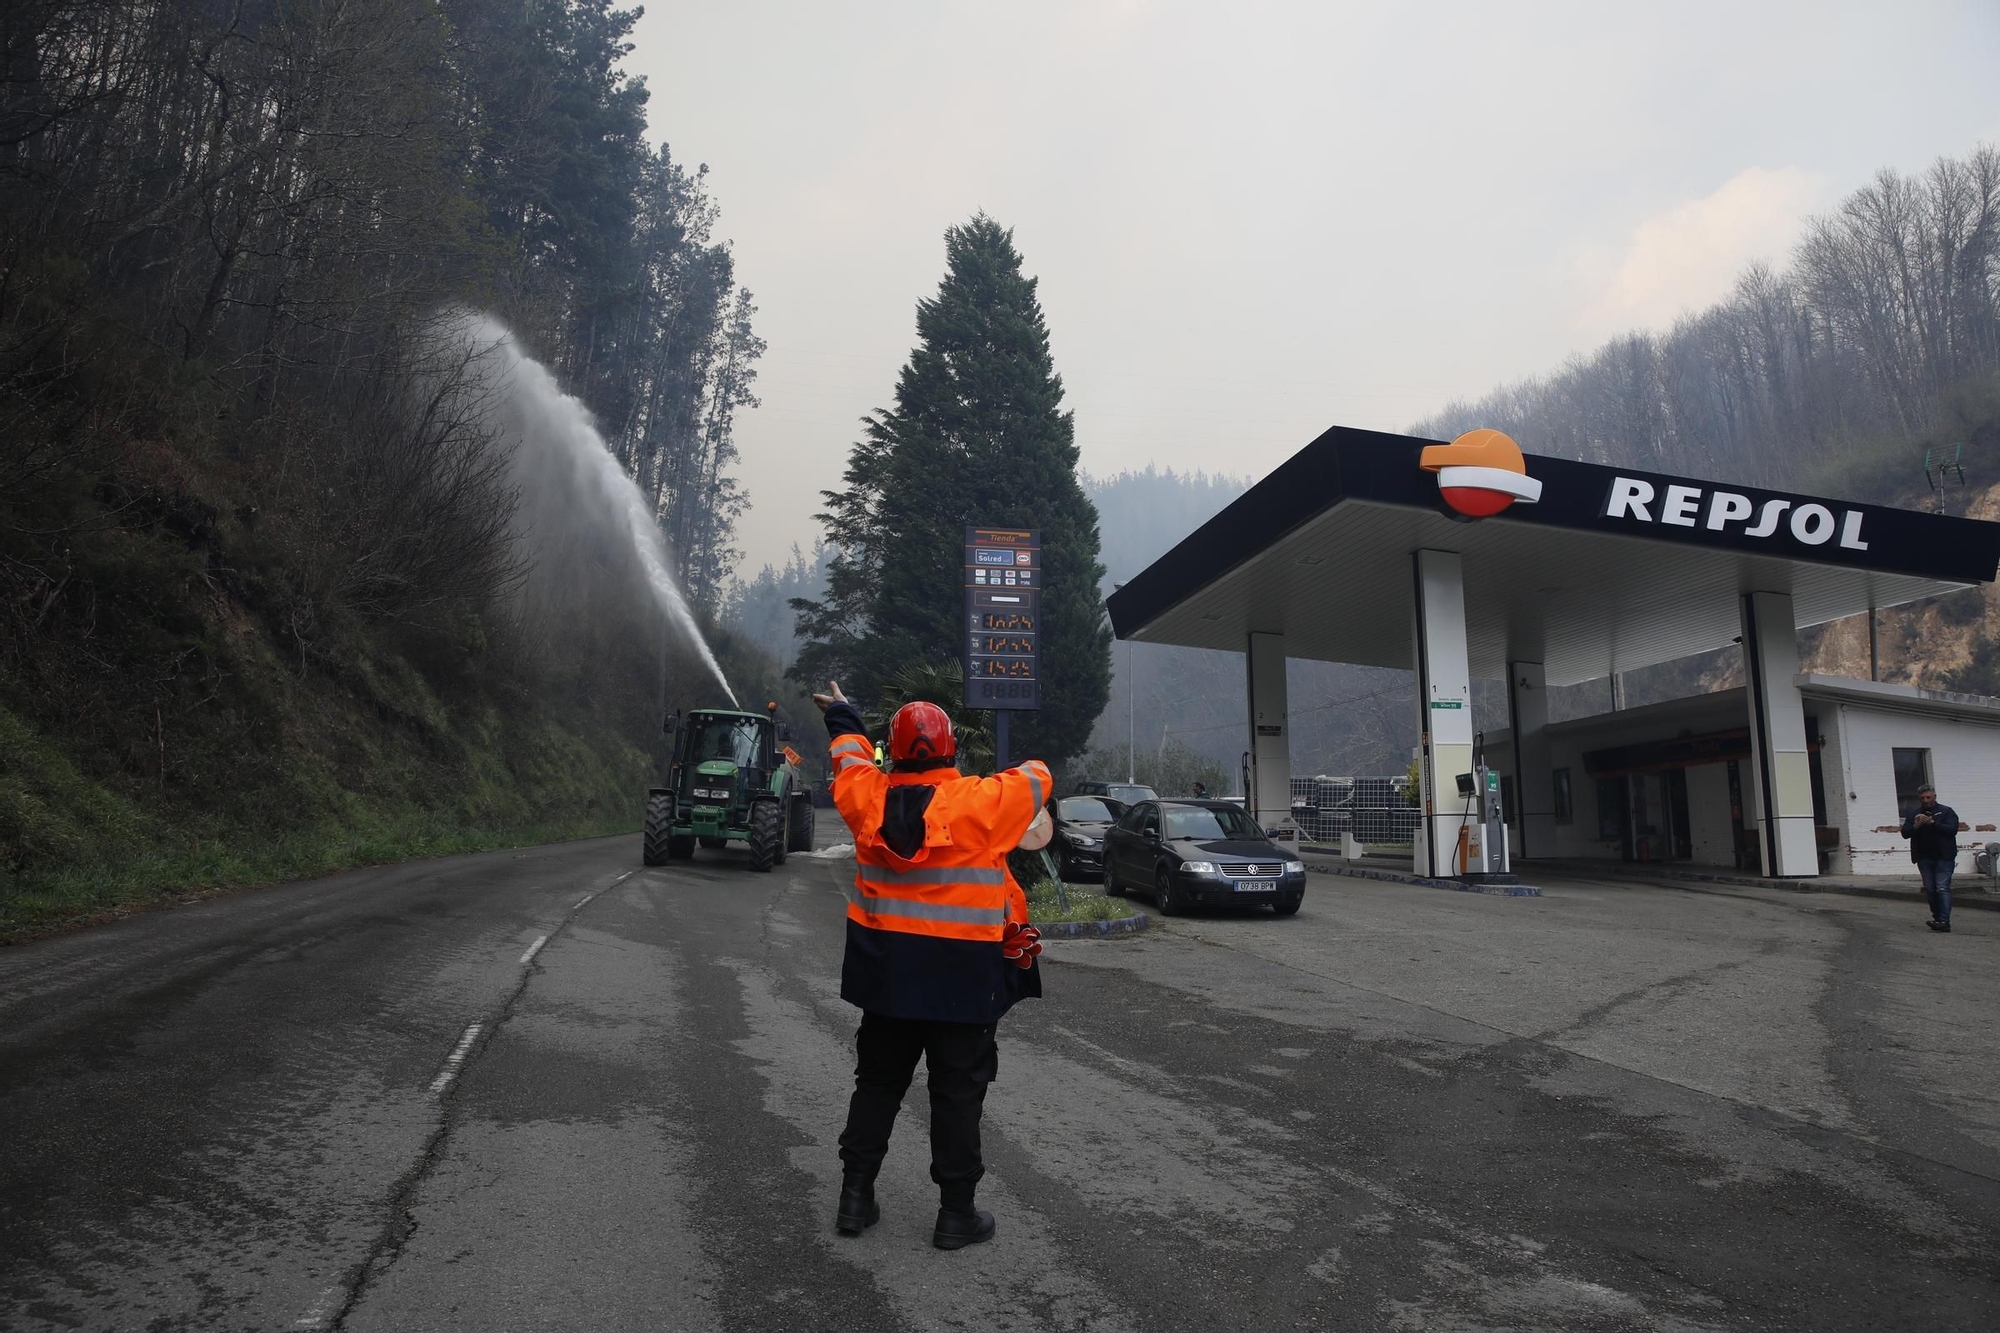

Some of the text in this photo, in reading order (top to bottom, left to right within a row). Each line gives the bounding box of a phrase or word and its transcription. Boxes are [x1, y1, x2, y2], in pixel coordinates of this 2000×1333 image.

[1606, 476, 1869, 551] REPSOL
[990, 534, 1016, 542] Tienda
[1240, 882, 1259, 890] 0738
